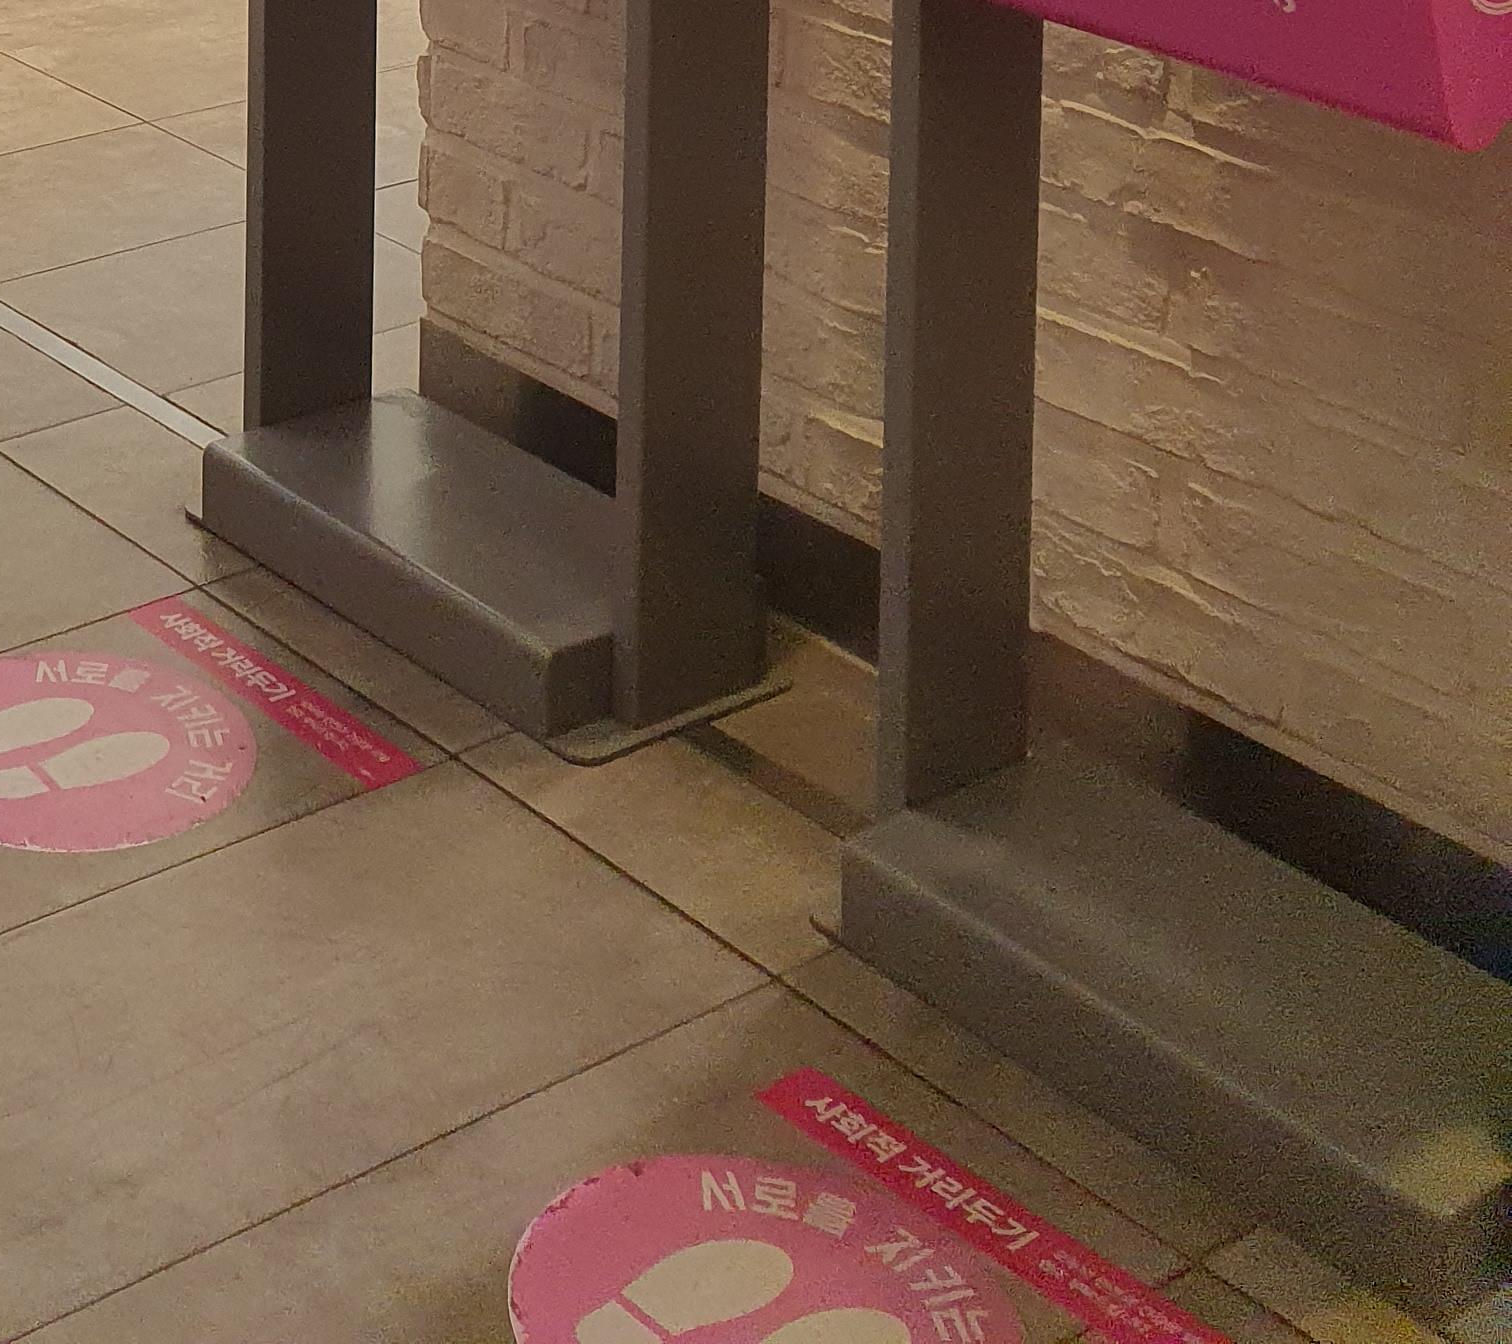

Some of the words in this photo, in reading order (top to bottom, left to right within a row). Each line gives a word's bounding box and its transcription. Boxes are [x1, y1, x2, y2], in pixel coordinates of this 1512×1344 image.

[34, 659, 152, 694] 서로를
[159, 611, 222, 655] 사회적
[210, 646, 294, 703] 거리두기
[151, 685, 232, 750] 지키는
[164, 759, 233, 804] 거리
[804, 1094, 906, 1162] 사회적
[898, 1152, 1042, 1252] 거리두기
[698, 1170, 860, 1240] 서로를
[864, 1230, 992, 1344] 지키는
